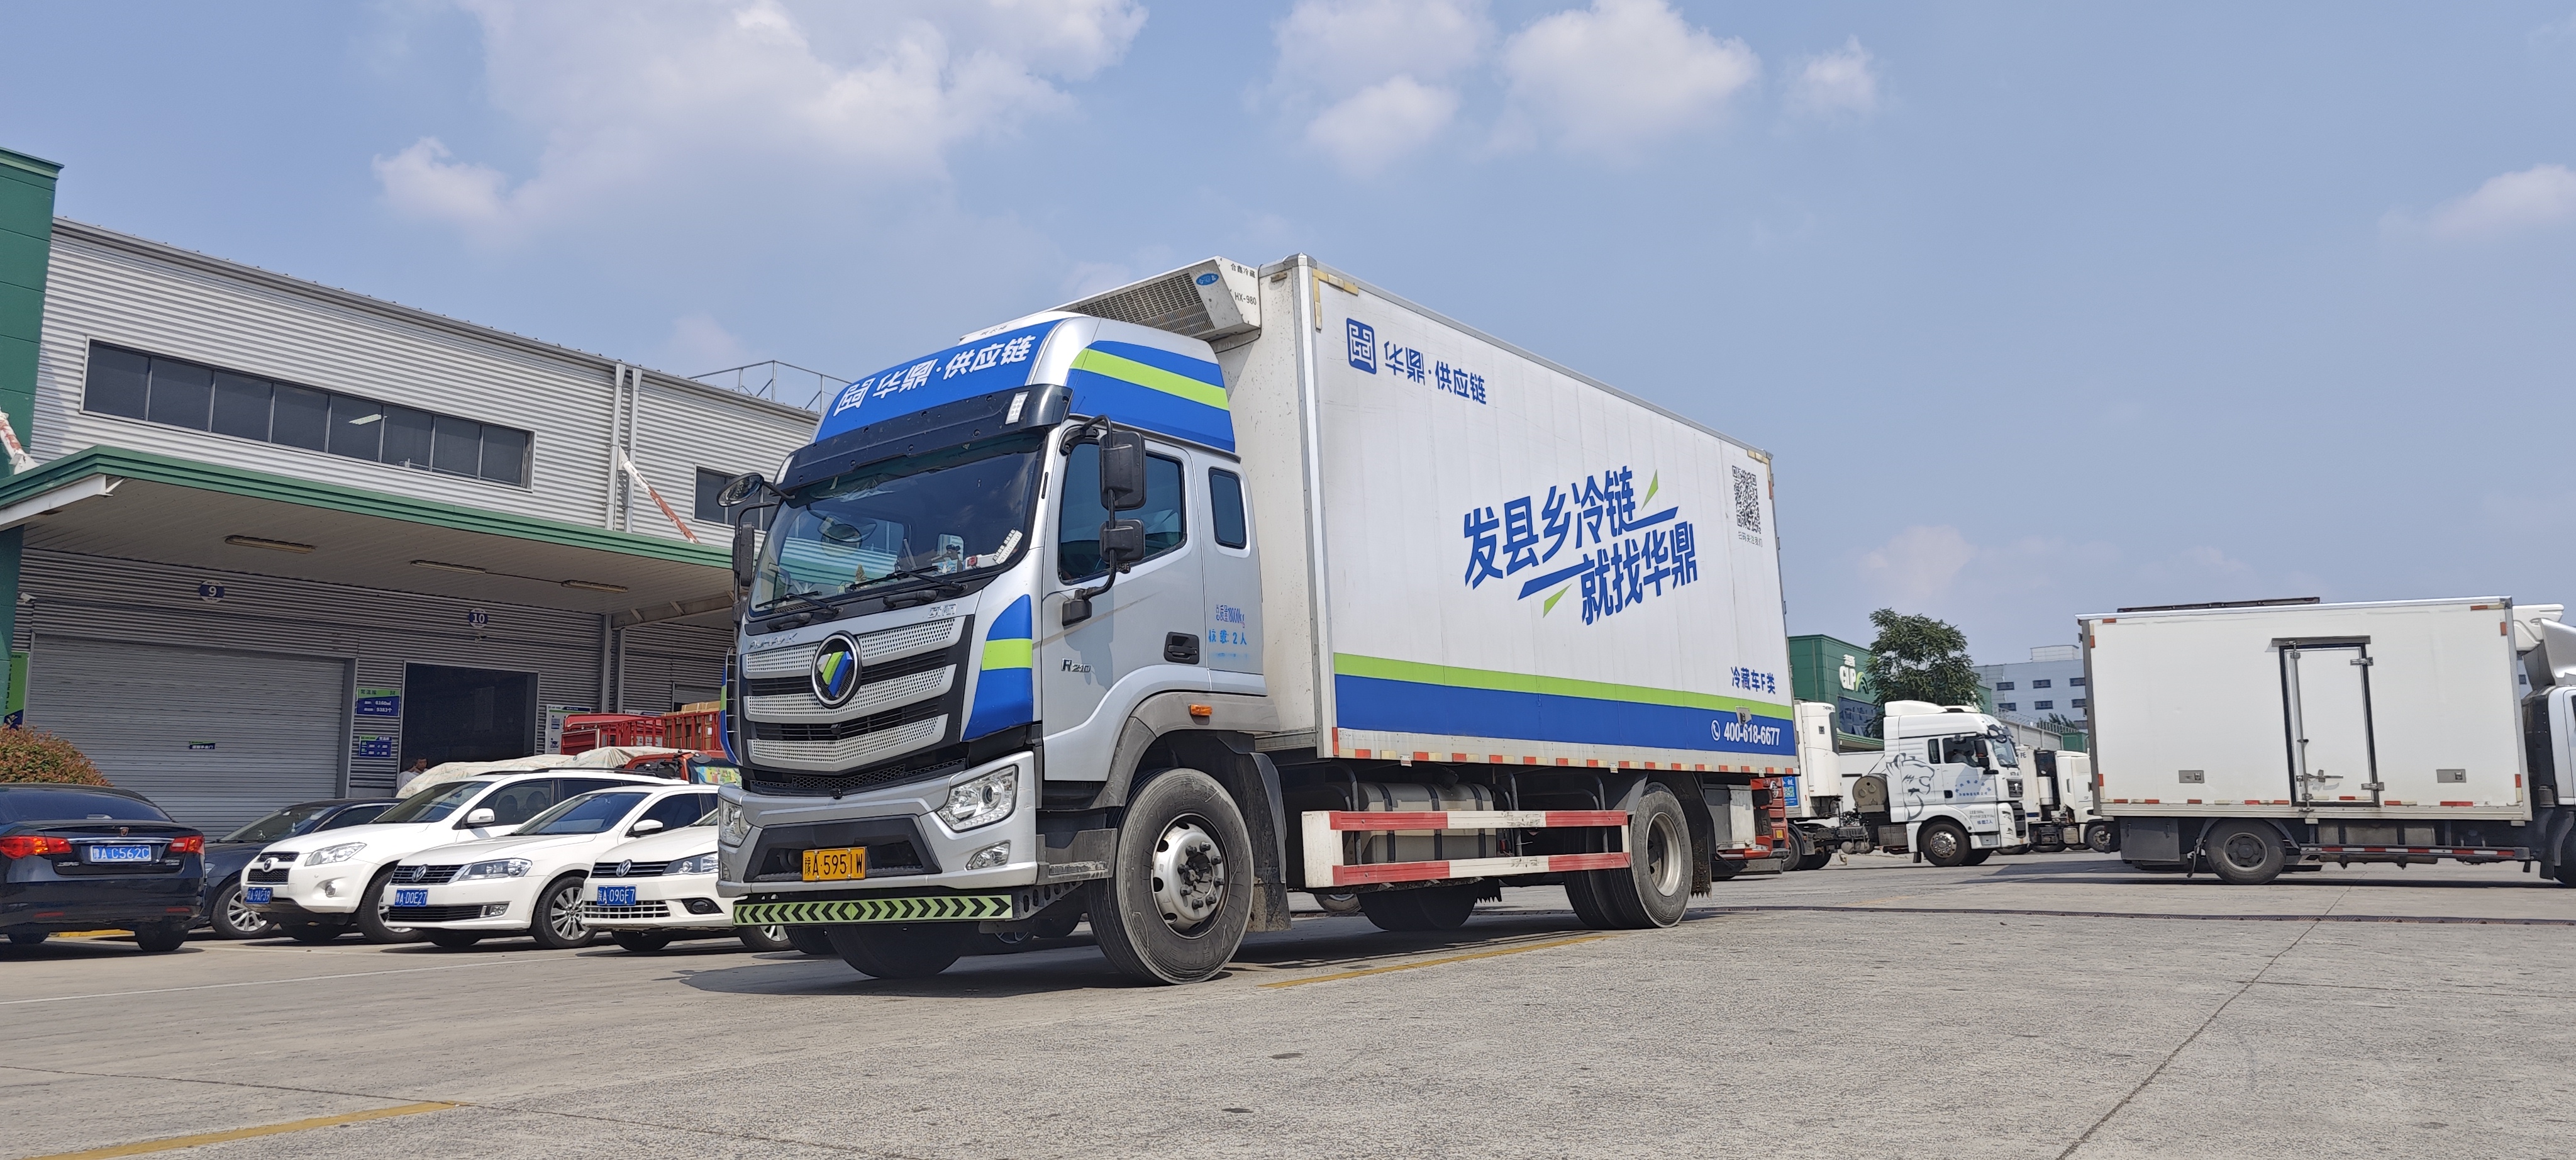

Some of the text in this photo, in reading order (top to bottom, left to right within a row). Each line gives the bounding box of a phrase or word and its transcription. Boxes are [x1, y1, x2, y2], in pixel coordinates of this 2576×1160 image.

[1235, 292, 1257, 305] HX-980
[1463, 466, 1636, 590] 发县乡冷链
[1580, 521, 1698, 626] 就找华鼎
[209, 586, 217, 597] 9
[472, 613, 485, 623] 10
[1730, 666, 1776, 694] 冷藏车F类
[1839, 666, 1857, 691] GLP
[1724, 722, 1780, 746] 400-618-6677
